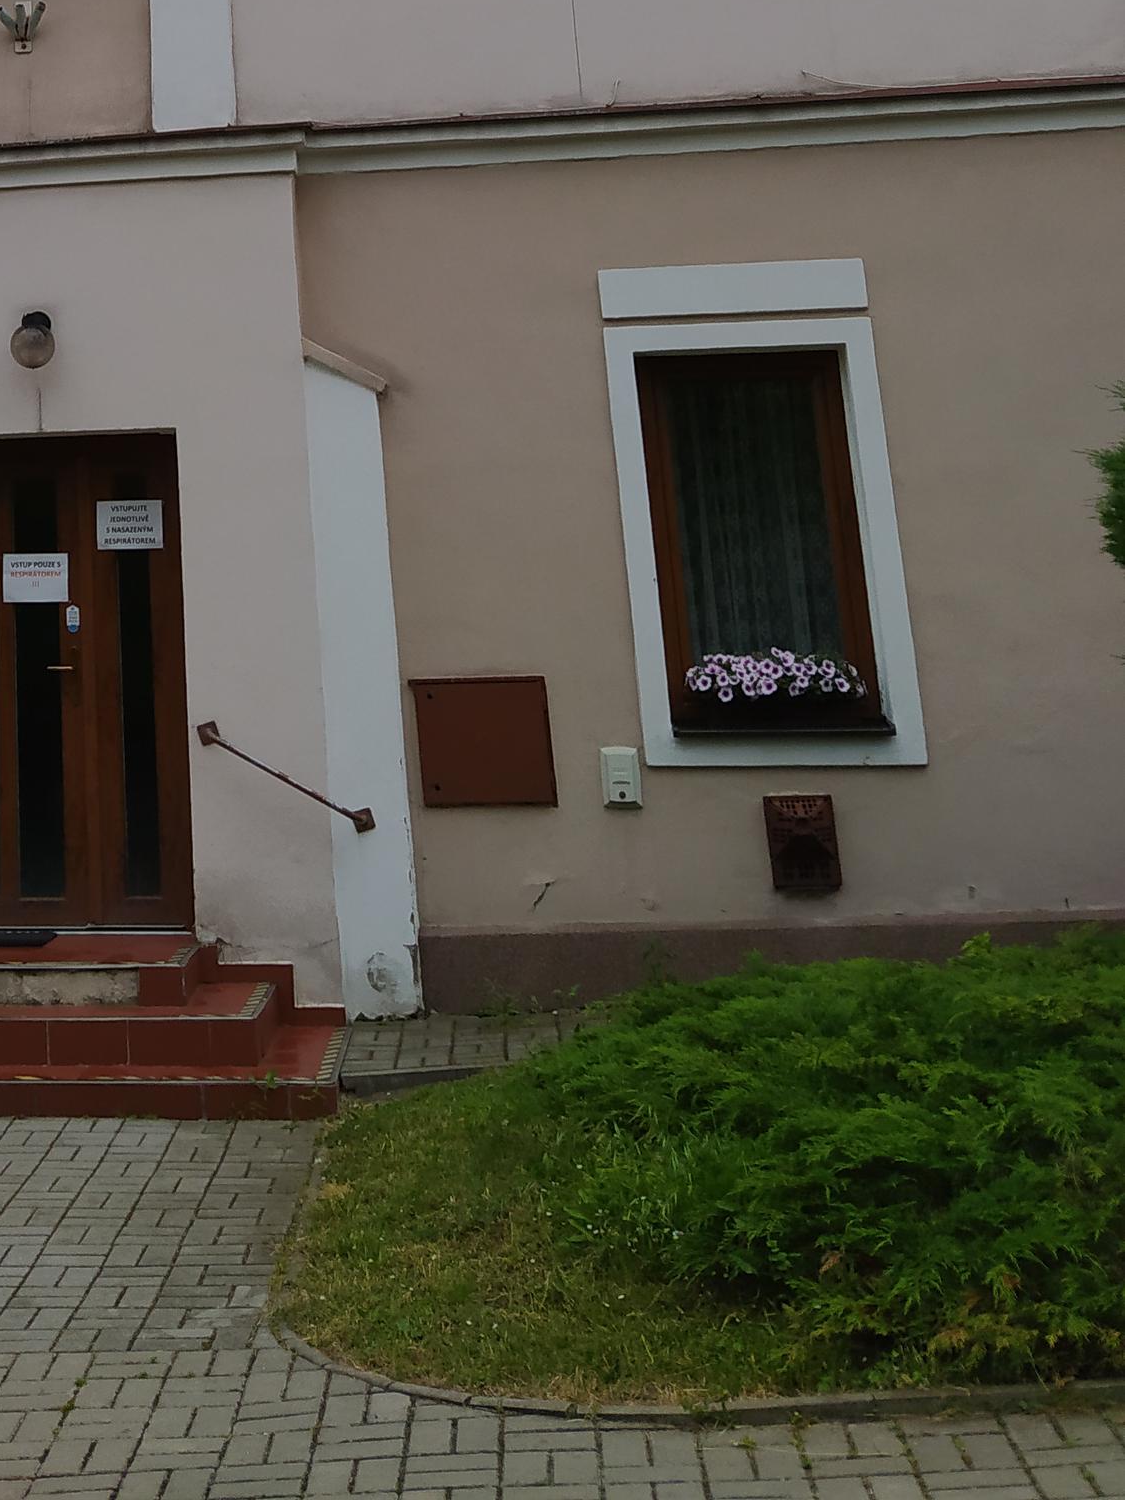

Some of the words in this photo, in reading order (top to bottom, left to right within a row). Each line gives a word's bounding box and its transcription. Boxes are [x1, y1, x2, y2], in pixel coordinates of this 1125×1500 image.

[110, 504, 148, 512] VSTUPUJTE
[111, 525, 154, 533] NASAZENÝM
[104, 537, 156, 545] RESPIRÁTOREM
